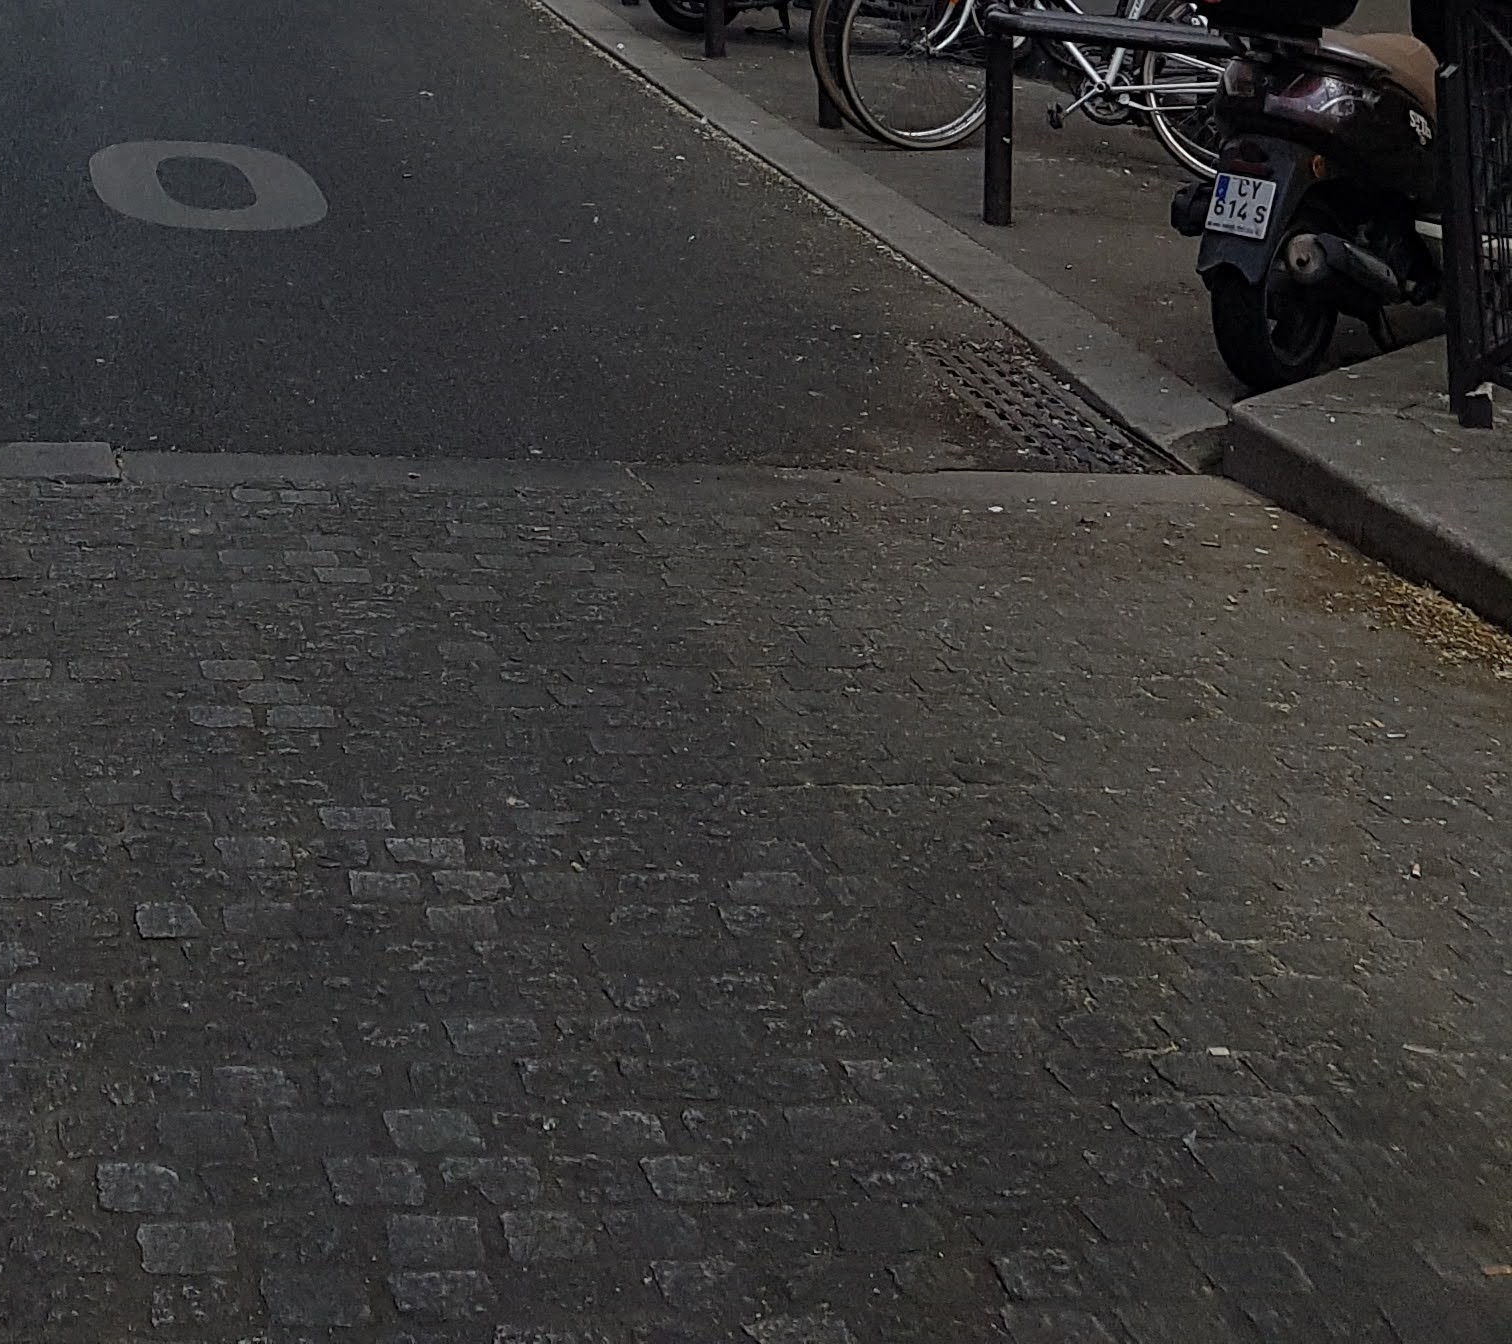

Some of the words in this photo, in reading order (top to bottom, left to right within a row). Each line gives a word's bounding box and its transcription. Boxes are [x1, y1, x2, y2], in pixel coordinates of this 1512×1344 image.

[1238, 179, 1262, 199] CY
[1213, 198, 1248, 221] 614
[1253, 205, 1267, 224] S
